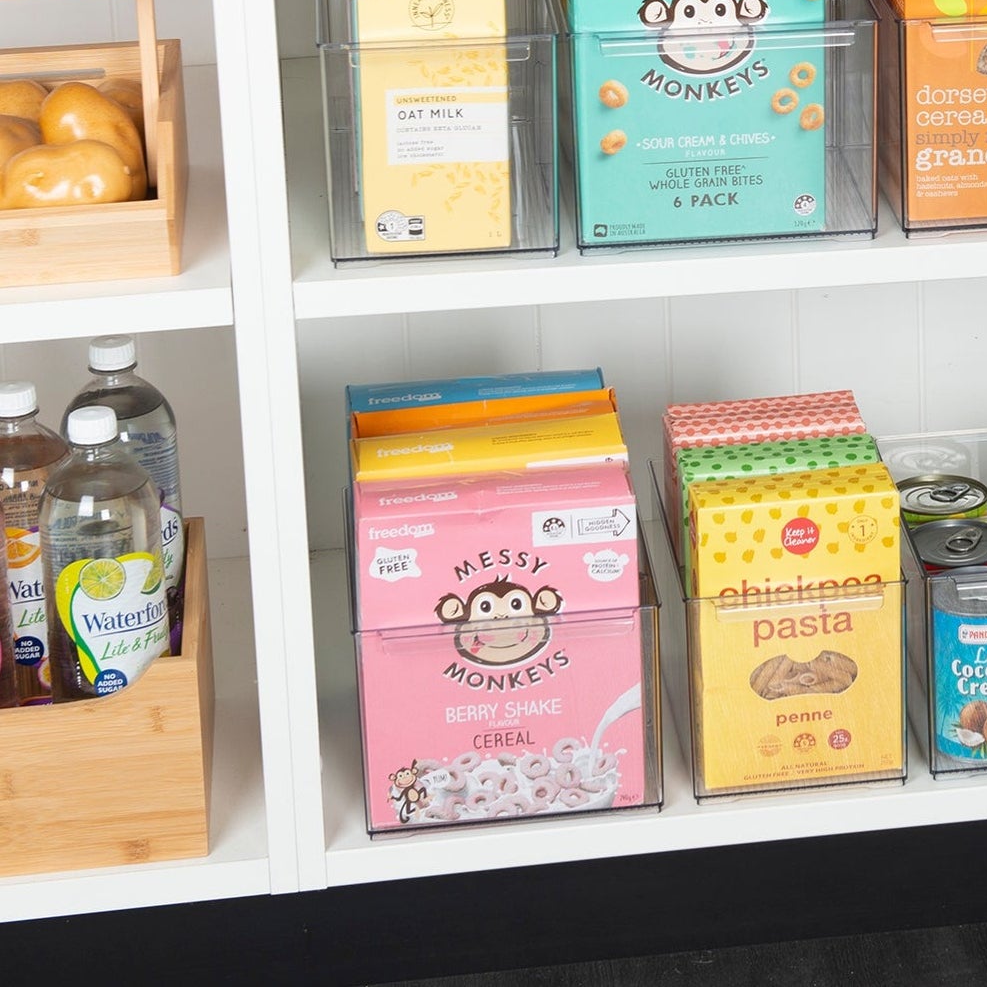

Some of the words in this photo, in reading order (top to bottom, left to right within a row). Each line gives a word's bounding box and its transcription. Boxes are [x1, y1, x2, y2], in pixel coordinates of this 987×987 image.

[640, 63, 770, 101] MONKEYS
[396, 95, 457, 104] UNSWEETENED
[398, 110, 424, 120] OAT
[430, 108, 464, 119] MILK
[642, 137, 674, 150] SOUR
[678, 135, 715, 148] CREAM
[719, 135, 727, 146] &
[730, 132, 770, 144] CHIVES
[916, 130, 980, 147] simply
[665, 167, 710, 178] GLUTEN
[649, 178, 691, 190] WHOLE
[694, 176, 729, 188] GRAIN
[732, 175, 764, 187] BITES
[673, 195, 683, 208] 6
[691, 192, 739, 208] PACK
[368, 391, 442, 405] freedom
[376, 442, 454, 458] freedom
[379, 490, 458, 507] freedom
[368, 522, 434, 540] freedom
[785, 527, 806, 538] Keep
[807, 526, 815, 535] it
[860, 525, 865, 537] 1
[784, 536, 816, 547] Cleaner
[376, 553, 411, 564] GLUTEN
[454, 549, 547, 583] MESSY
[379, 562, 409, 575] FREE
[753, 604, 854, 648] pasta
[15, 652, 40, 660] SUGAR
[100, 640, 131, 661] Lite
[132, 636, 142, 651] &
[103, 672, 117, 681] NO
[443, 649, 569, 692] MONKEYS
[97, 678, 124, 688] ADDED
[446, 702, 498, 724] BERRY
[504, 698, 563, 718] SHAKE
[776, 708, 833, 727] penne
[473, 730, 536, 750] CEREAL
